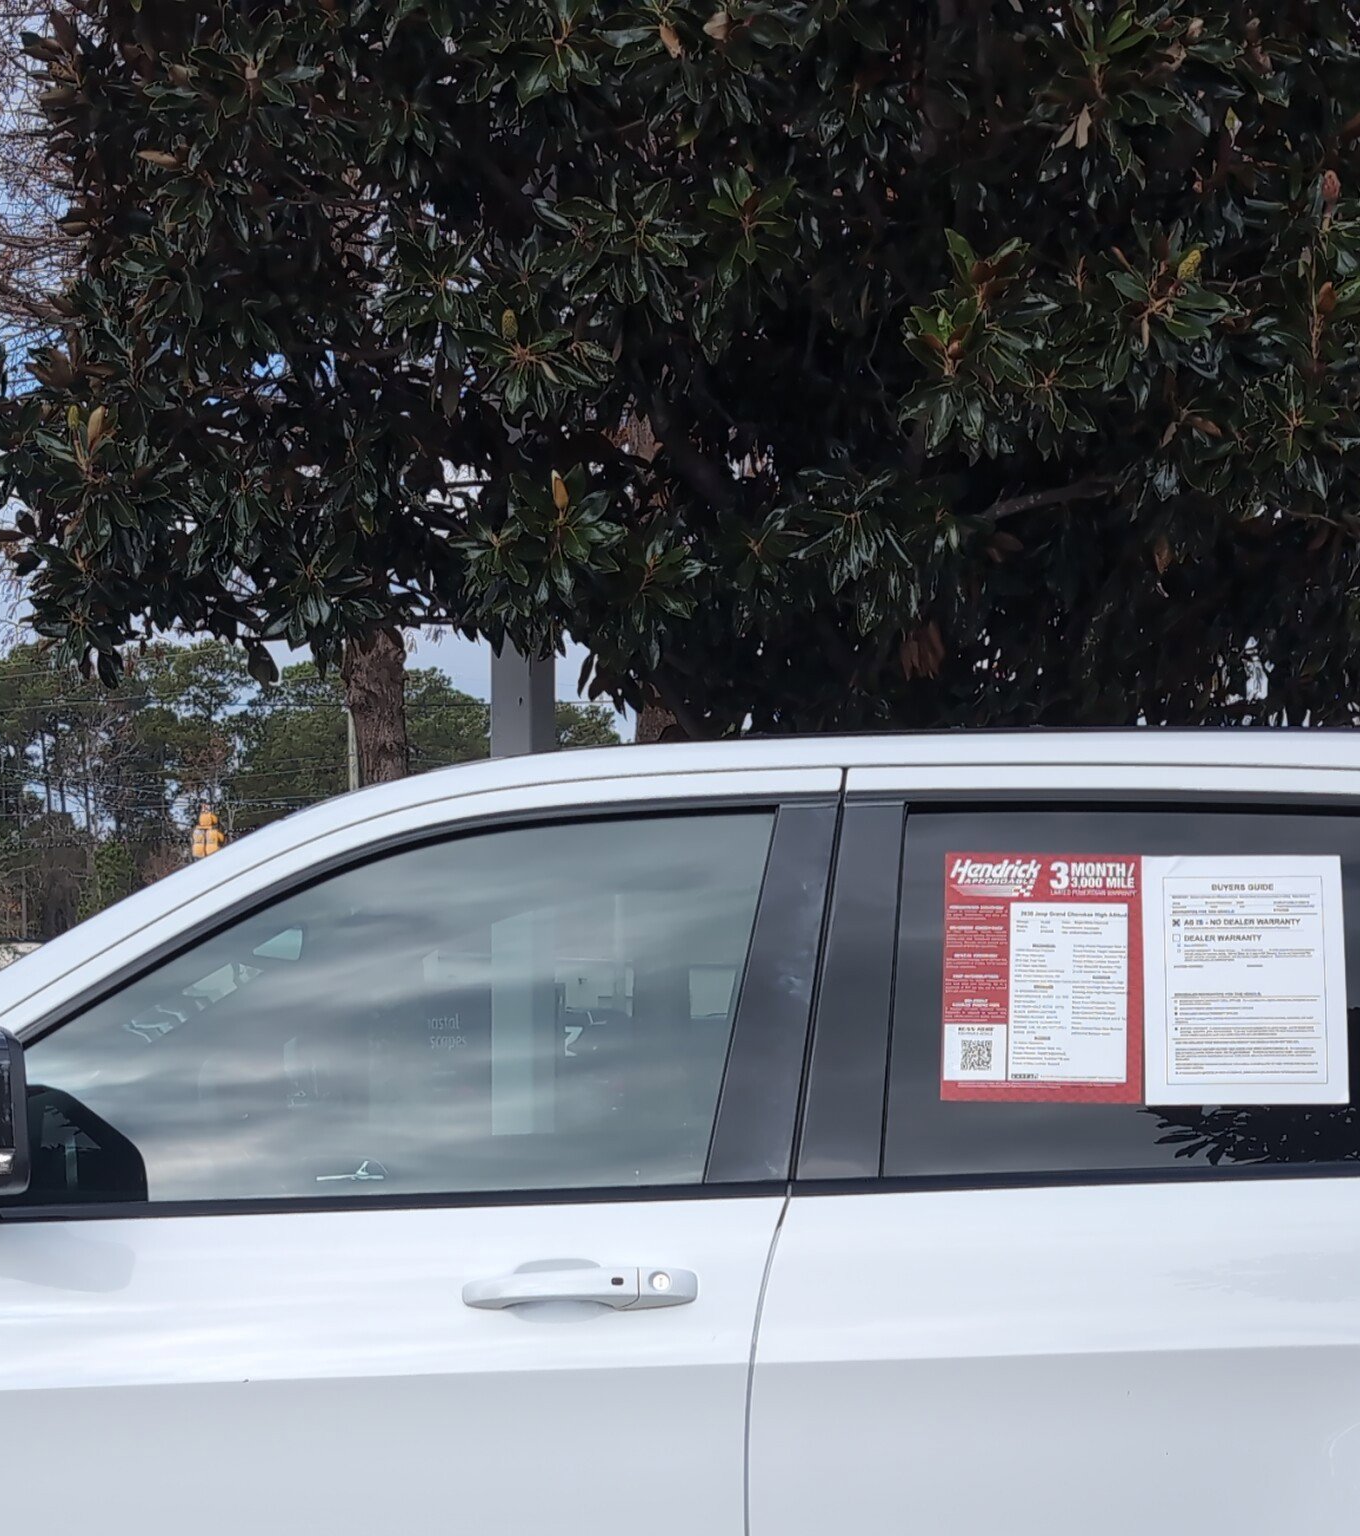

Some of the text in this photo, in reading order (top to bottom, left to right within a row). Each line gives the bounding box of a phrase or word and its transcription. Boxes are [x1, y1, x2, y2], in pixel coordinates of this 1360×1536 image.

[950, 858, 1042, 884] Hendrick
[1049, 861, 1070, 889] 3
[1071, 862, 1135, 878] MONTH/
[1070, 877, 1135, 889] 3,000 MILE
[1211, 883, 1274, 891] BUYERS GUIDE
[1184, 934, 1215, 942] DEALER
[428, 1013, 460, 1030] astal
